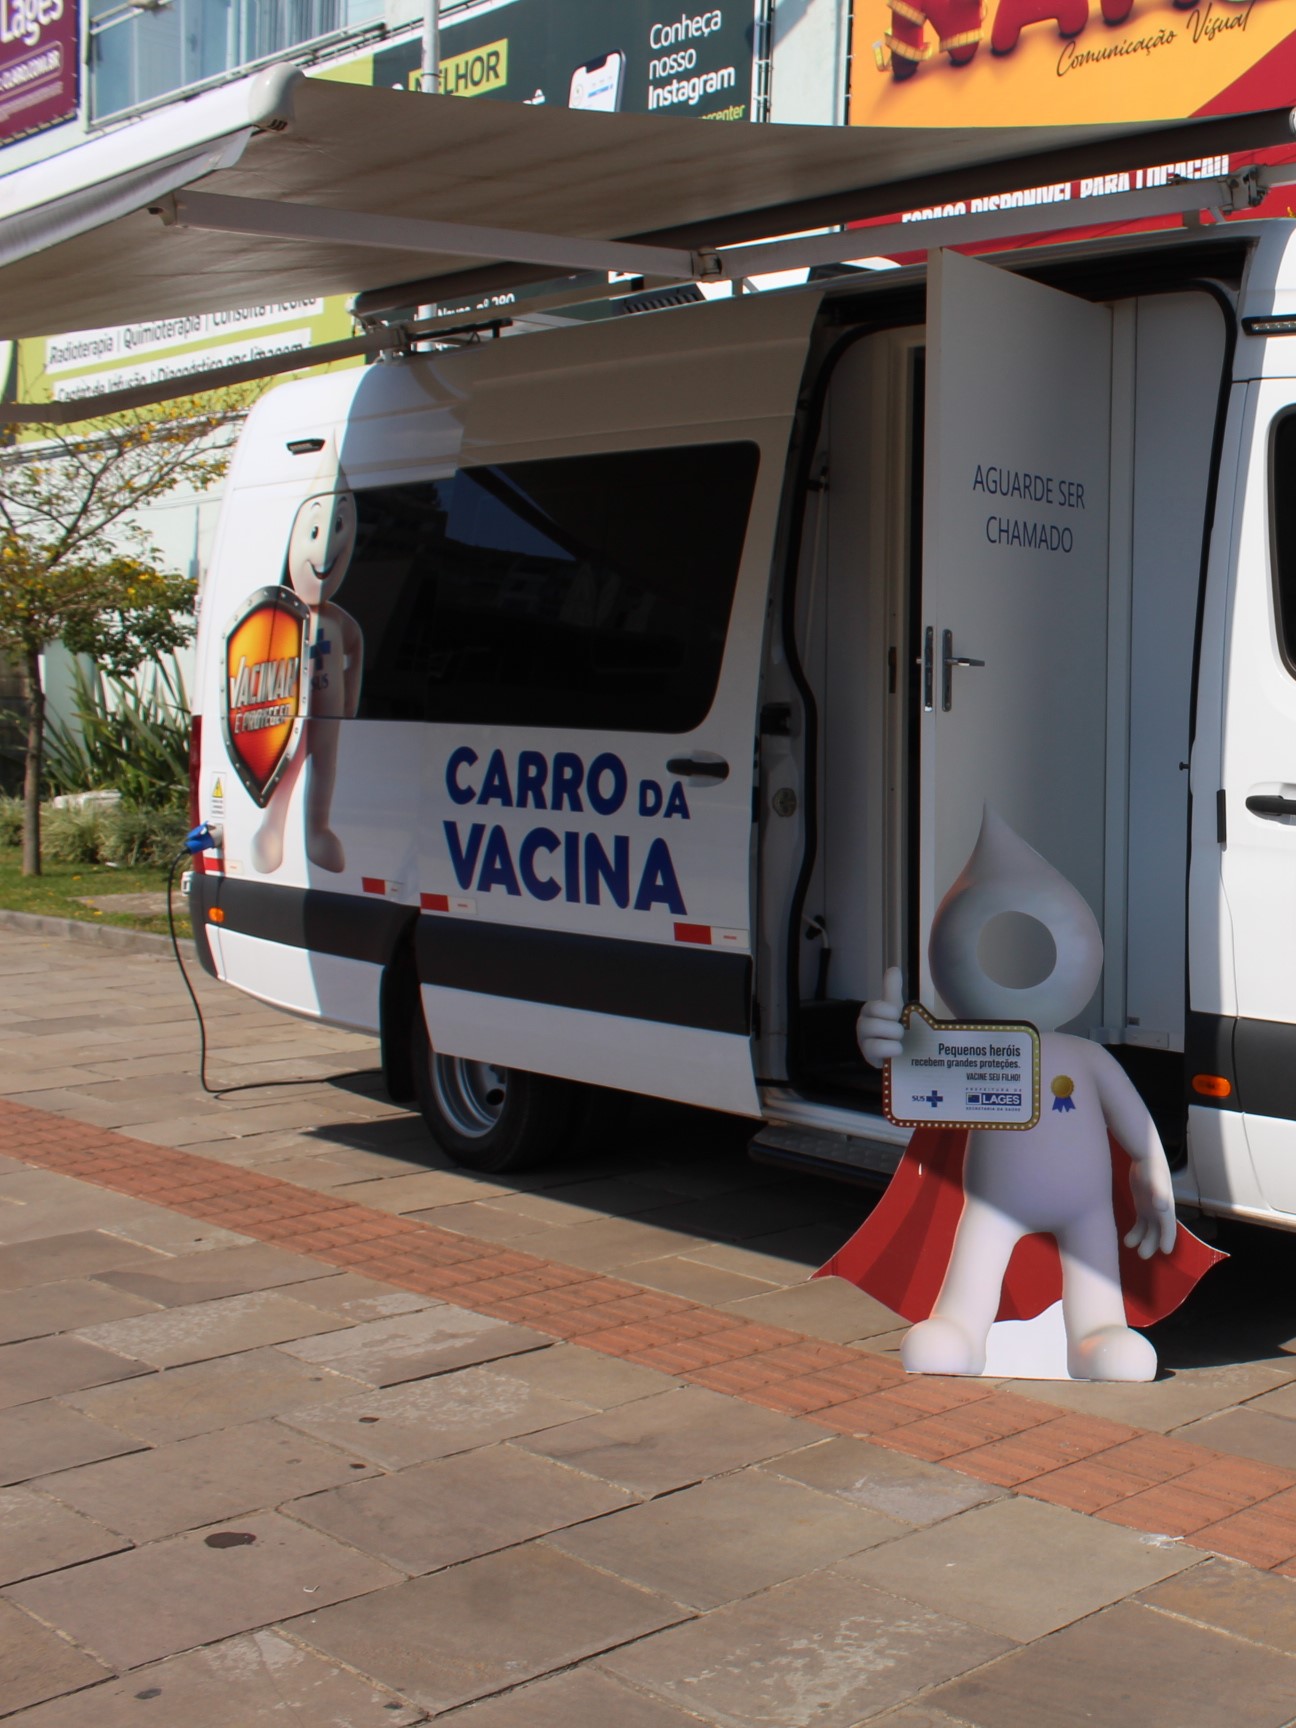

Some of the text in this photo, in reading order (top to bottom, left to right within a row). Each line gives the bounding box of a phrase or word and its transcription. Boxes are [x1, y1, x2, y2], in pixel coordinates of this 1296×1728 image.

[650, 9, 722, 49] Conheça
[1056, 30, 1176, 77] Comunicação
[1186, 1, 1255, 43] Visual
[414, 50, 500, 95] LHOR
[649, 48, 697, 80] nosso
[648, 66, 735, 110] Instagram
[50, 334, 113, 364] Radioterapia
[124, 315, 201, 348] Quimioterapia
[973, 464, 1085, 509] AGUARDE SER
[986, 516, 1073, 553] CHAMADO
[445, 746, 691, 820] CARRO DA
[442, 820, 688, 916] VACINA
[911, 1057, 1021, 1069] recebem grandes proteções.
[938, 1043, 1021, 1057] Pequenos heróis
[966, 1072, 1021, 1082] VACINE SEU FILHO!
[982, 1094, 1020, 1105] LAGES
